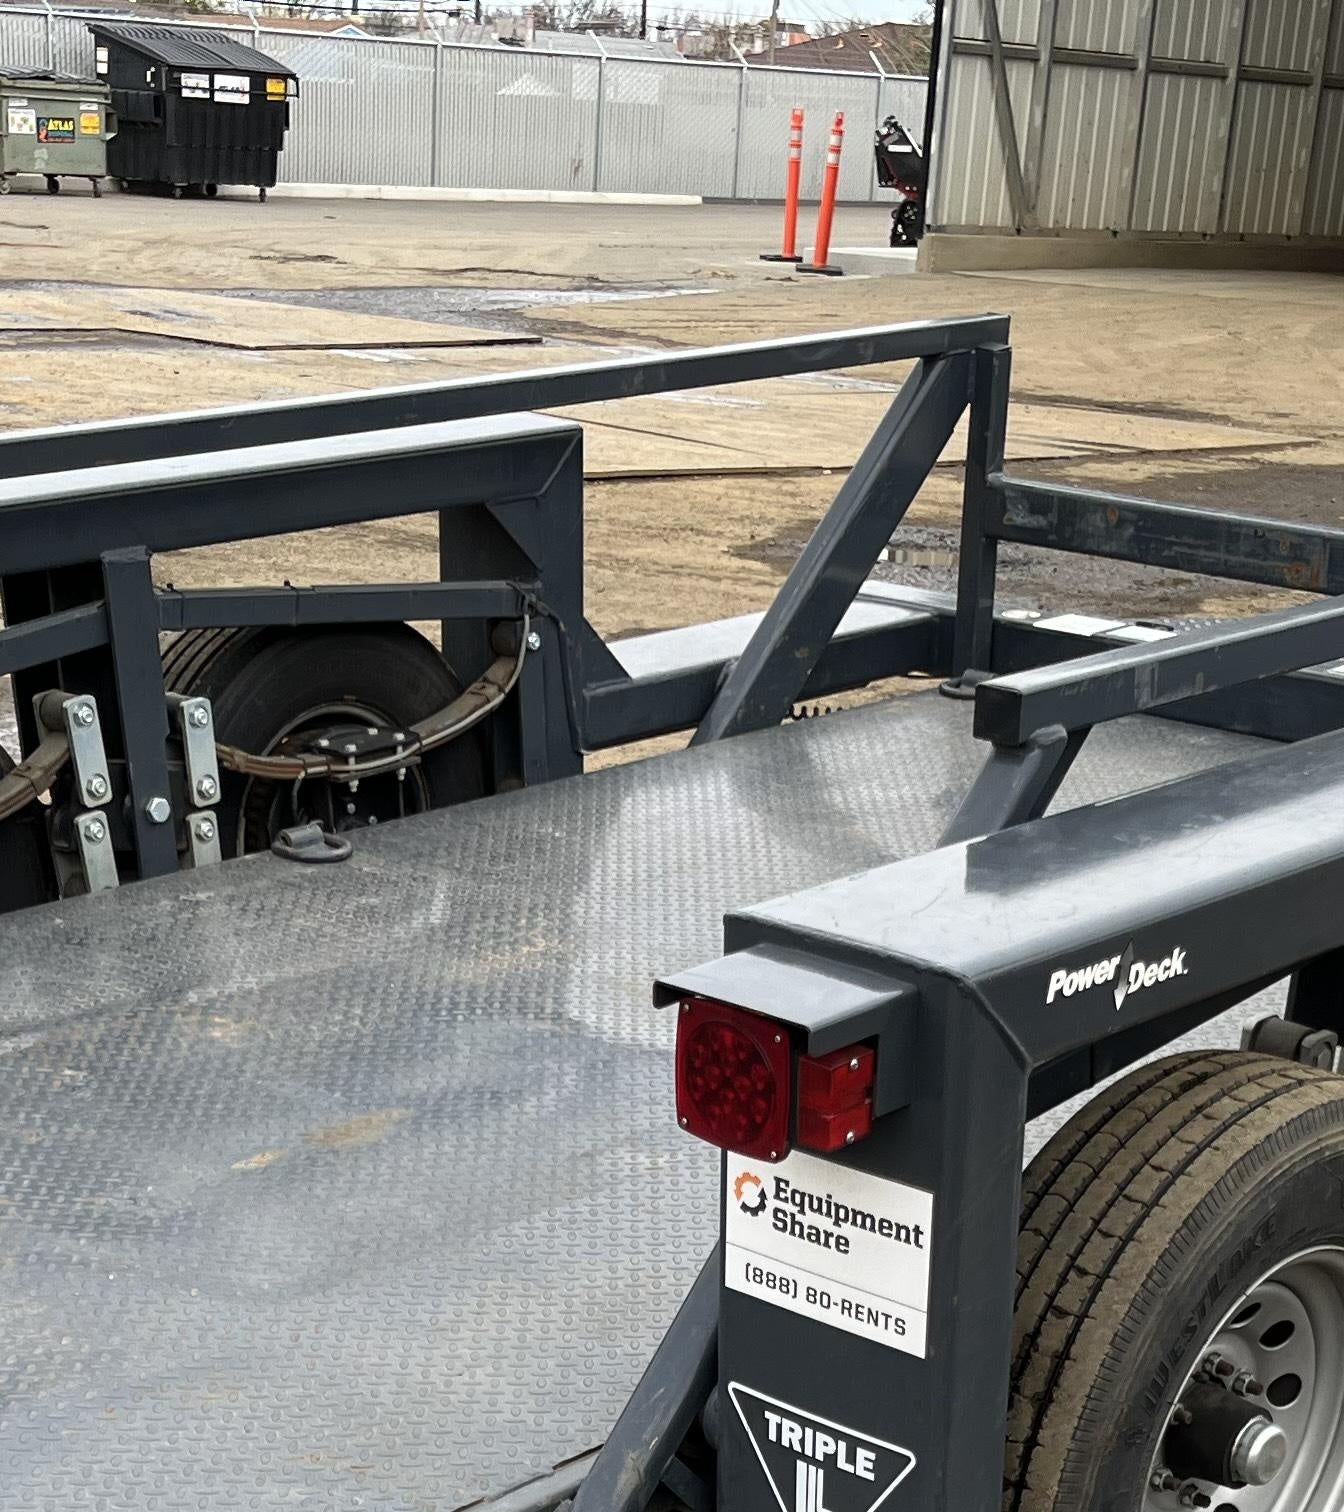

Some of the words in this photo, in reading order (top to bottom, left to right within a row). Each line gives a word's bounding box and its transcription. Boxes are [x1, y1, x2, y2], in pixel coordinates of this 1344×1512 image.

[47, 119, 74, 130] ATLAS
[1046, 955, 1121, 1005] Power
[772, 1206, 850, 1255] Share
[773, 1176, 925, 1249] Equipment
[745, 1262, 798, 1299] (888)
[806, 1286, 906, 1336] 80-RENTS
[764, 1410, 876, 1482] TRIPLE
